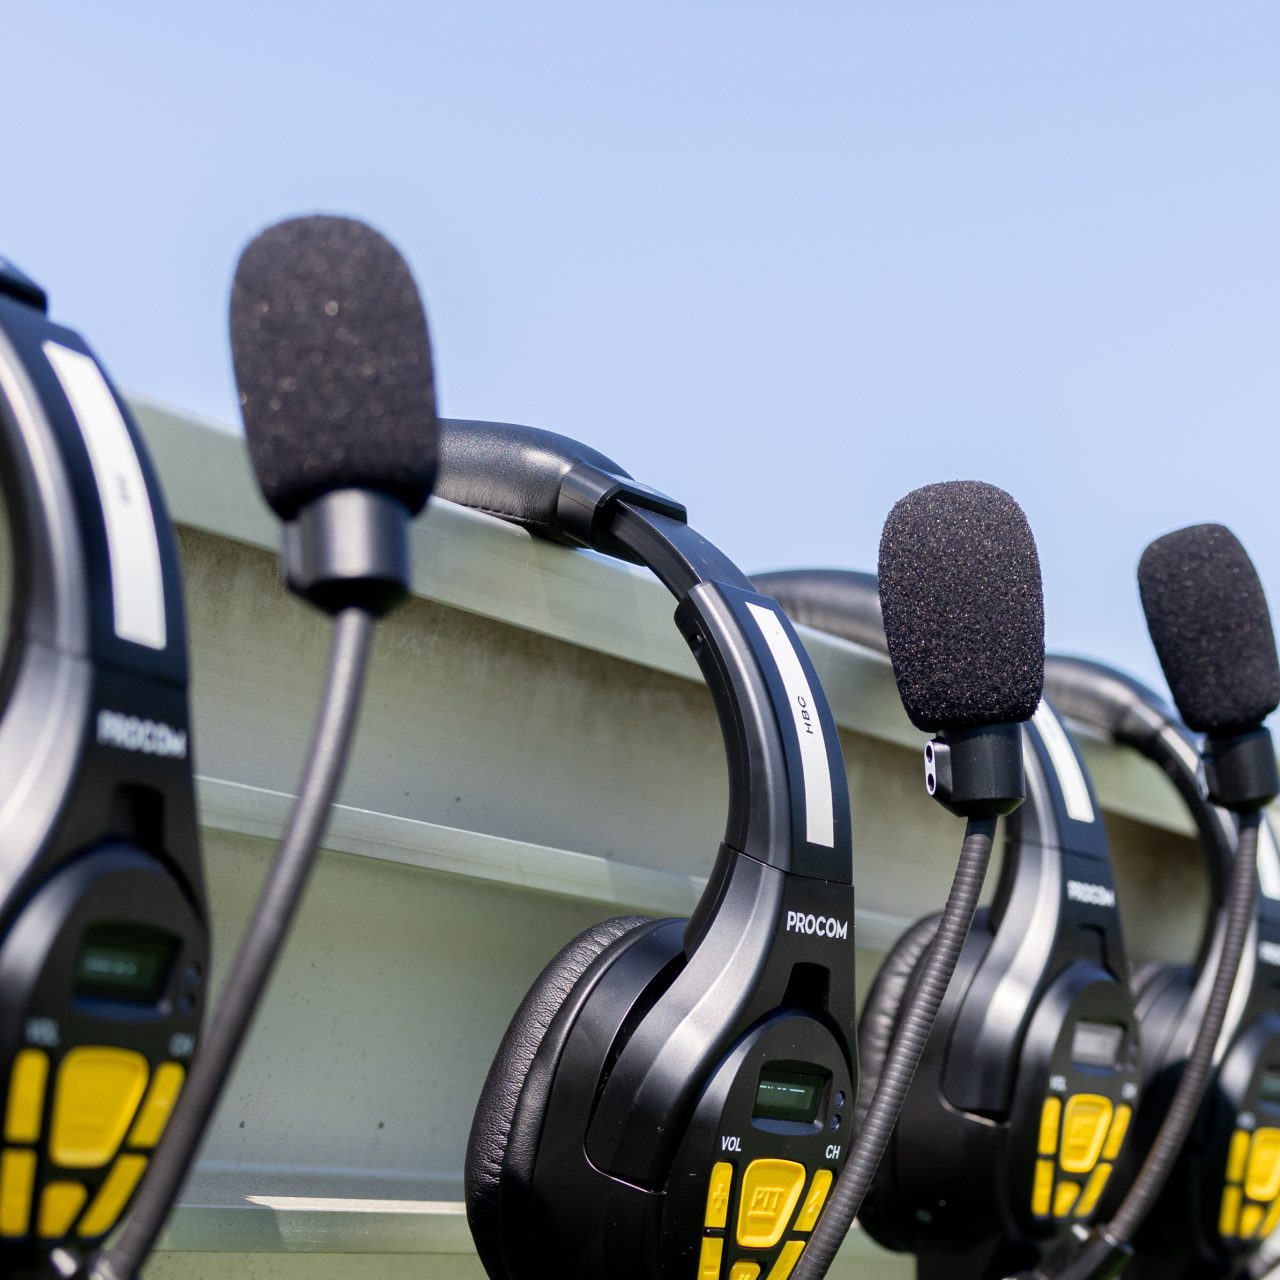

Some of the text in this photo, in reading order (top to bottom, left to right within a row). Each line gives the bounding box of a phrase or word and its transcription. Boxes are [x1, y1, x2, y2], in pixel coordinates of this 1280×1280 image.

[797, 696, 814, 734] HBC
[786, 911, 848, 939] PROCOM
[721, 1136, 742, 1151] VOL
[825, 1145, 841, 1159] CH
[751, 1187, 784, 1208] PTT
